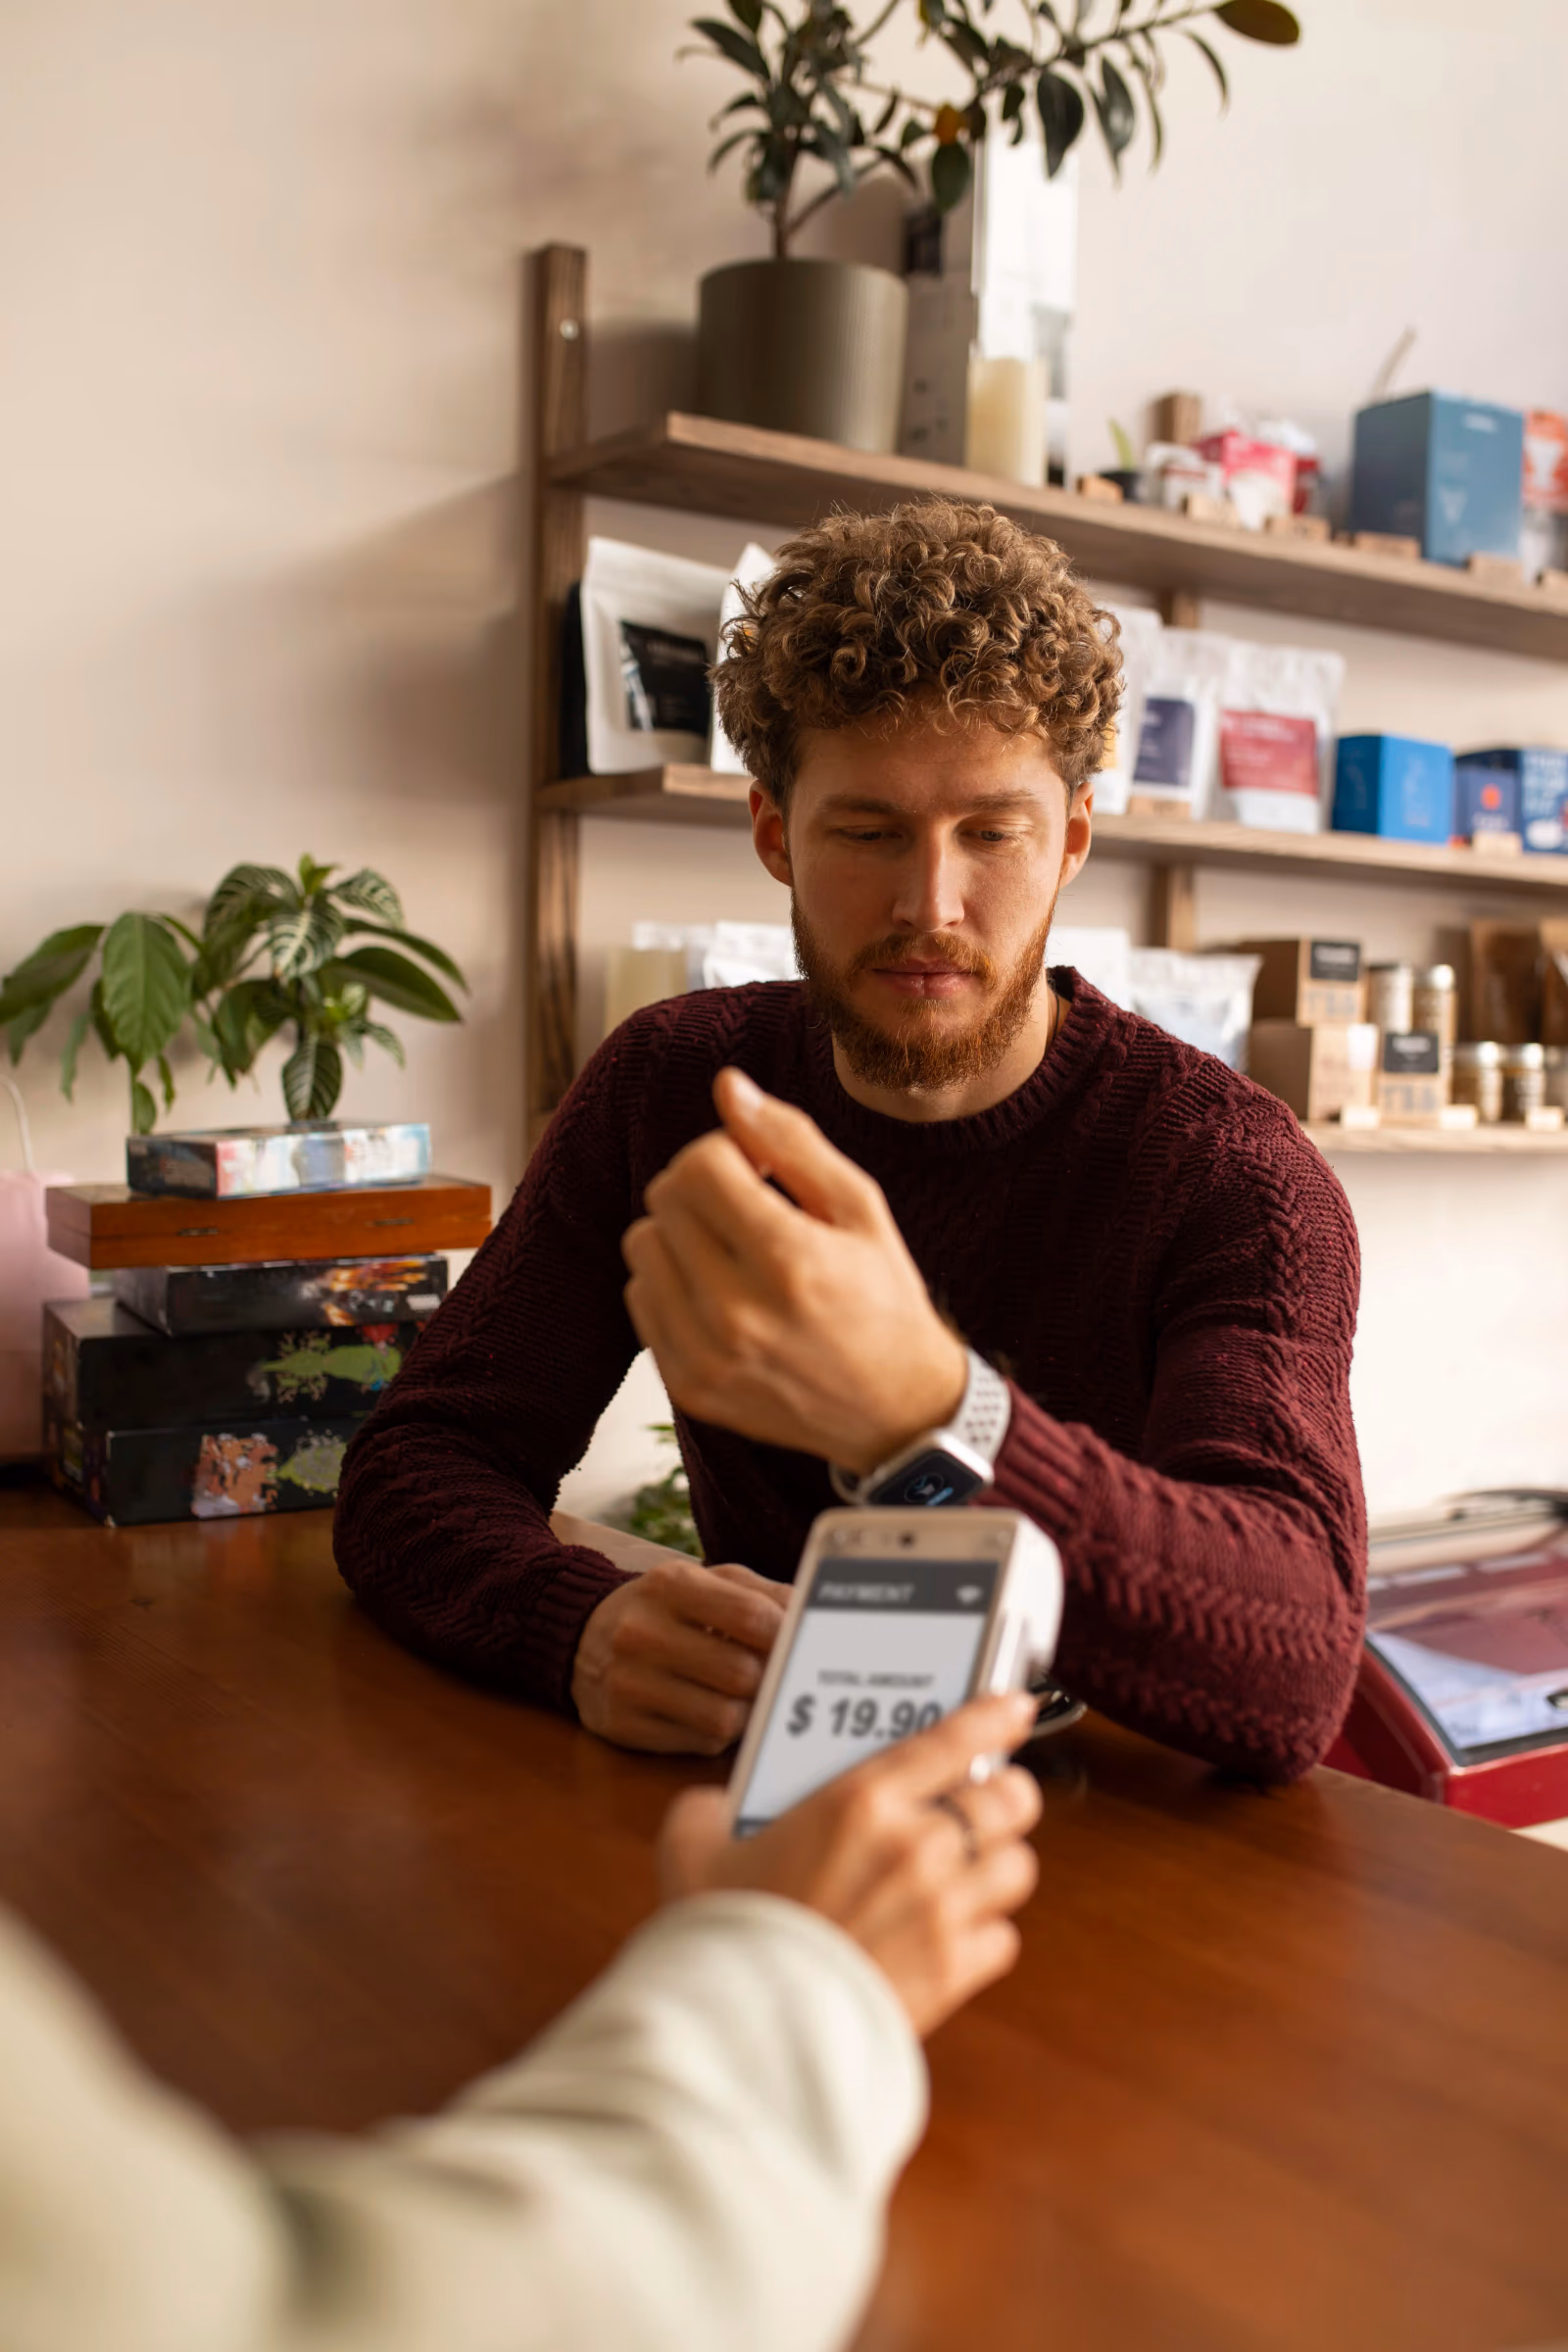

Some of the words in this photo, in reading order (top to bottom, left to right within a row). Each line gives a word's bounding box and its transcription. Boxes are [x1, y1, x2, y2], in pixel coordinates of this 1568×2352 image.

[818, 1582, 914, 1601] PAYMENT
[817, 1670, 861, 1687] TOTAL
[868, 1672, 934, 1689] AMOUNT
[787, 1694, 815, 1737] $
[831, 1697, 943, 1740] 19.90
